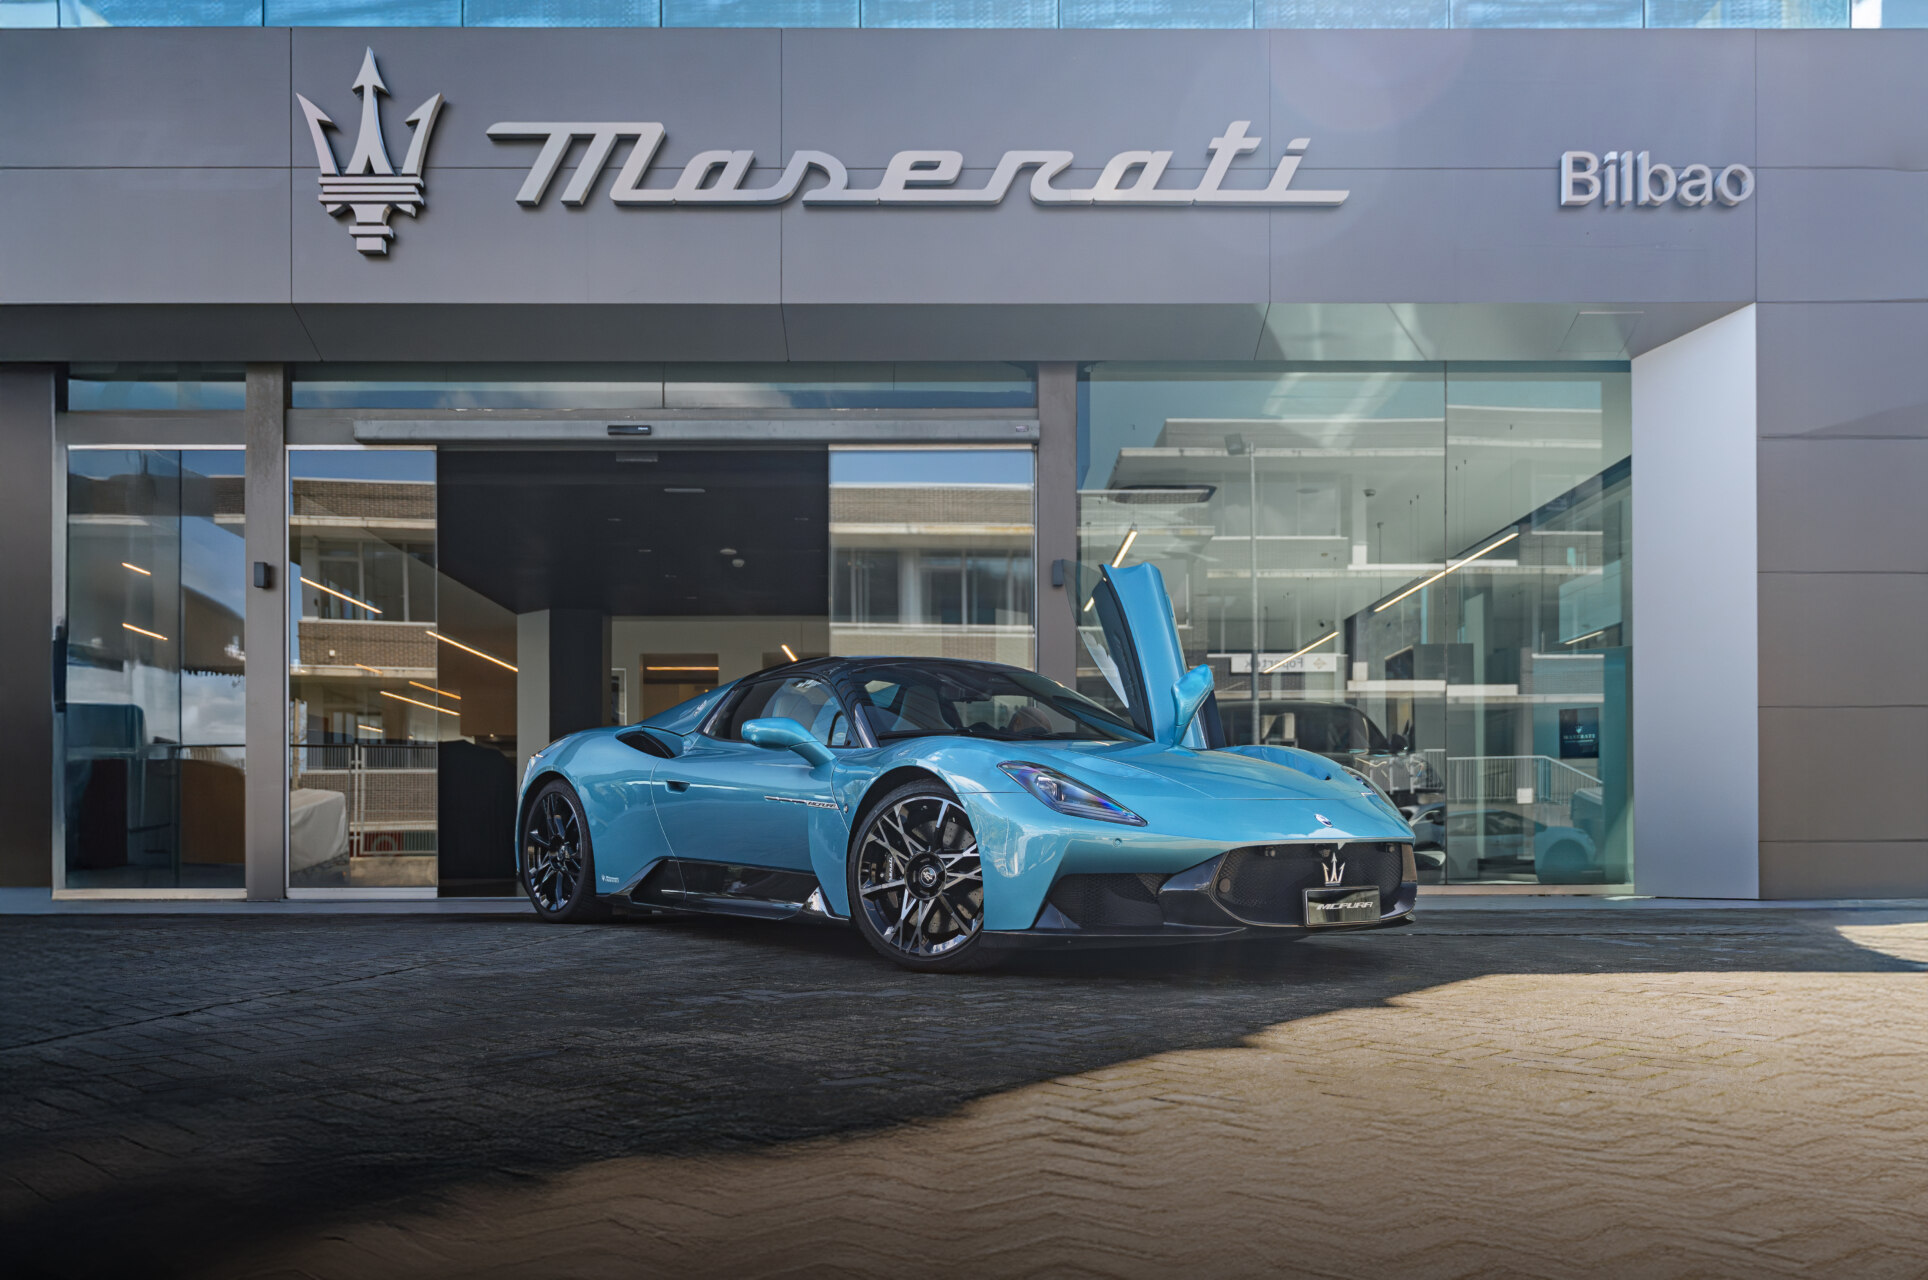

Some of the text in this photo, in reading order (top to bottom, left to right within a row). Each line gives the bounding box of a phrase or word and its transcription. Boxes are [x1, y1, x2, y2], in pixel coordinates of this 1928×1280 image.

[486, 120, 1350, 206] Maserati
[1560, 151, 1755, 206] Bilbao
[1316, 901, 1374, 911] MCPURA
